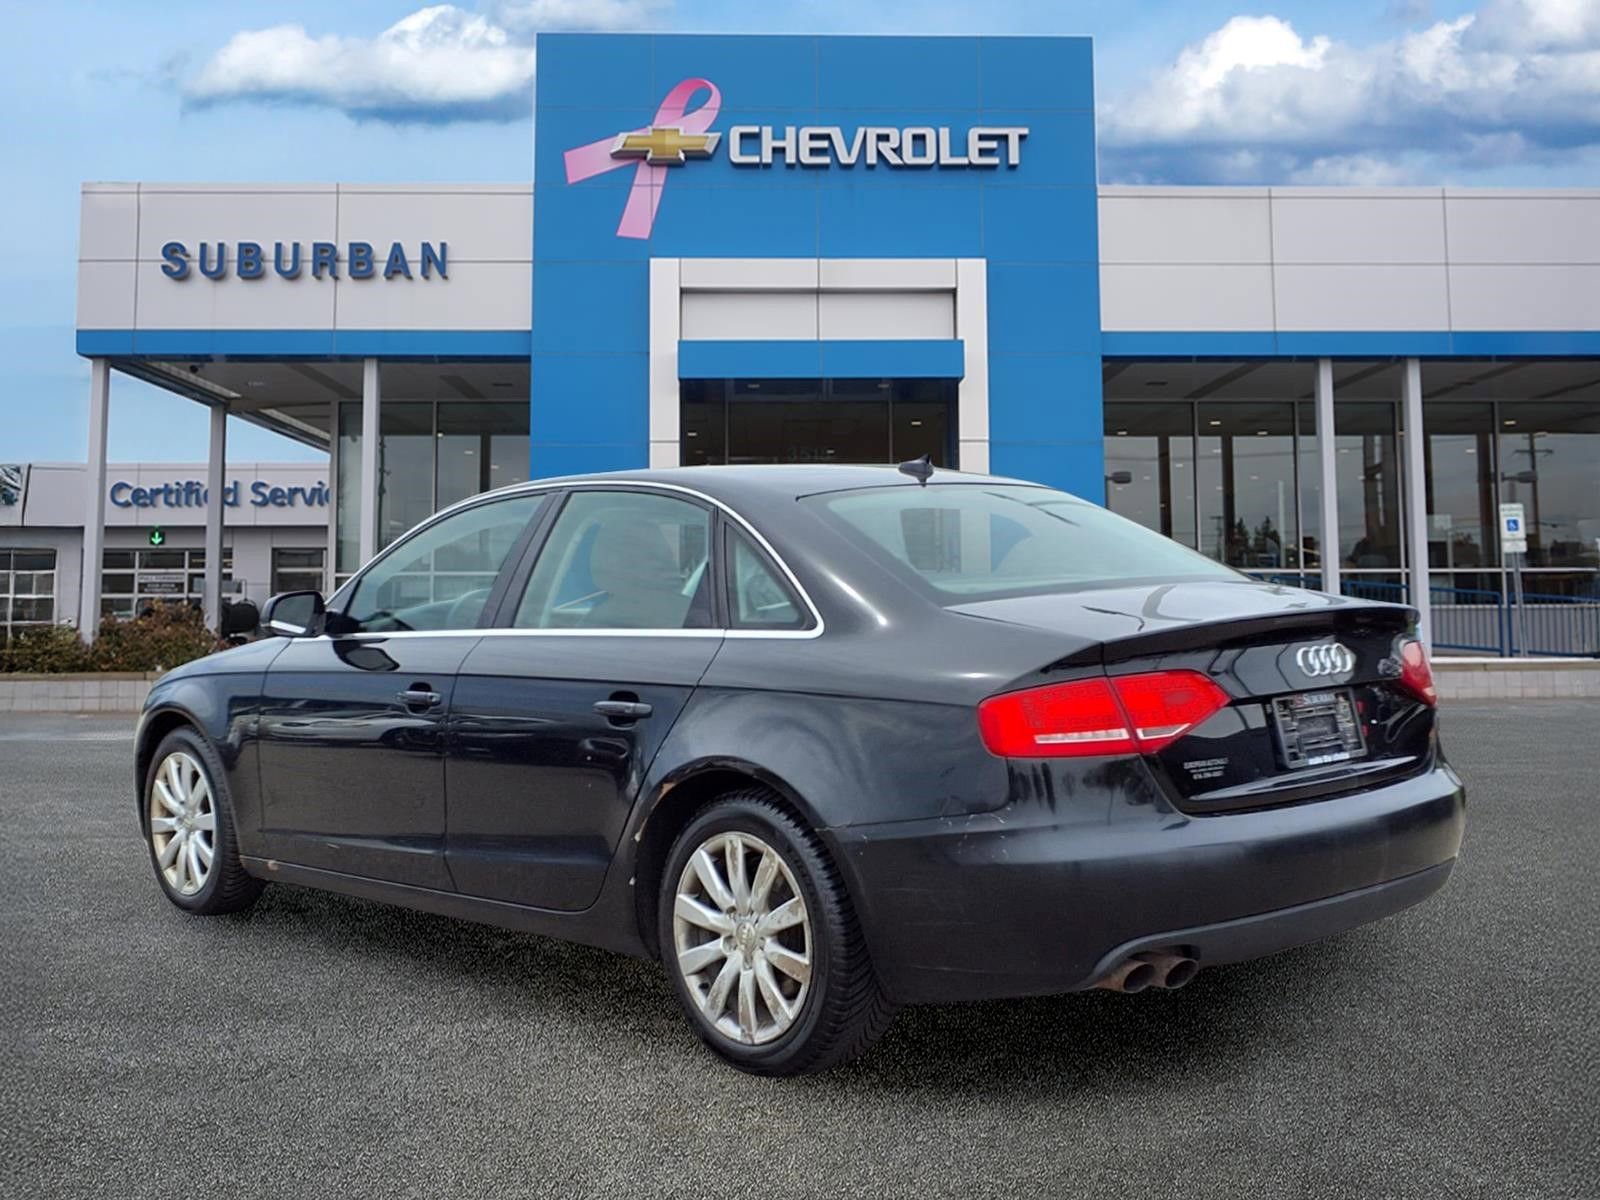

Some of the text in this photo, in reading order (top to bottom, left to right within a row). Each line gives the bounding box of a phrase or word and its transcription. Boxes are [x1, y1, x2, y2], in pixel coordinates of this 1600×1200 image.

[729, 125, 1029, 165] CHEVROLET
[161, 242, 449, 281] SUBURBAN
[110, 480, 329, 508] Certifid Servi
